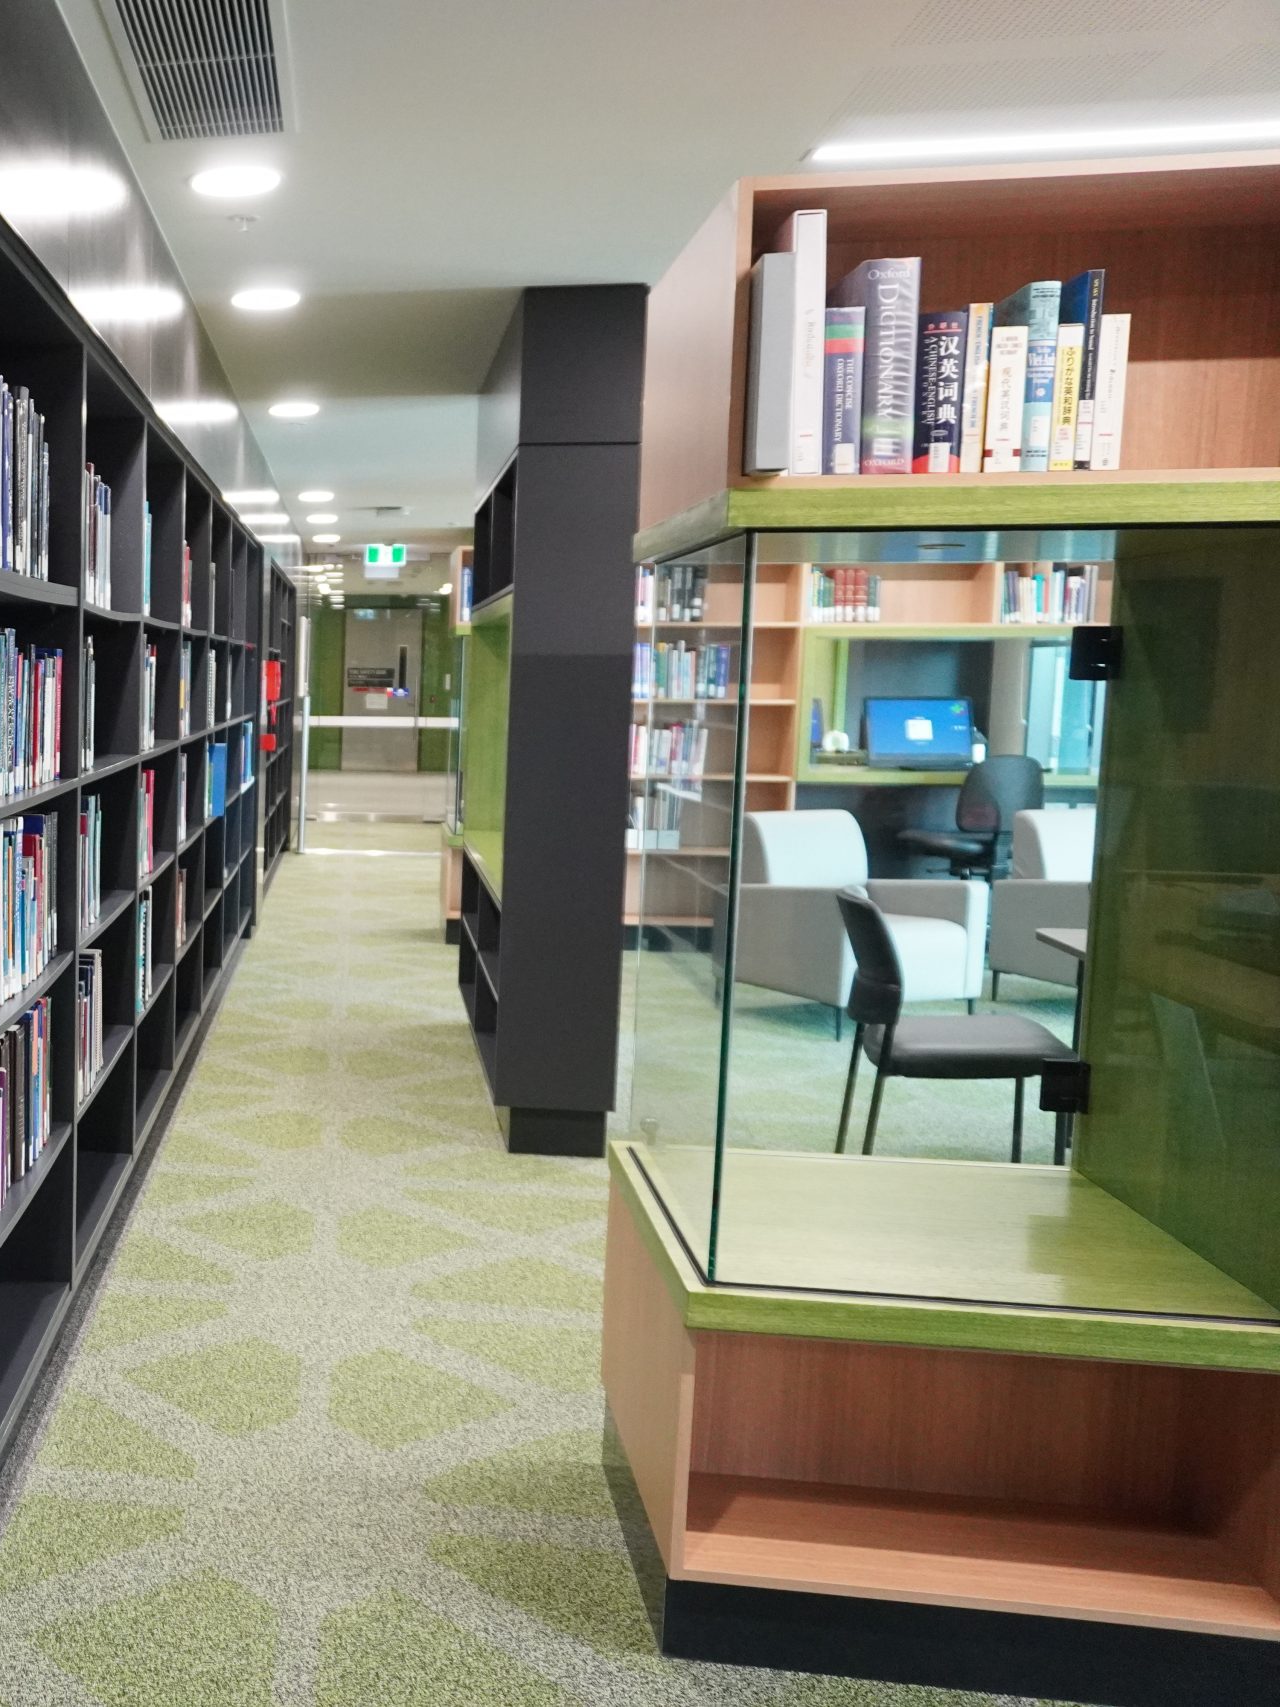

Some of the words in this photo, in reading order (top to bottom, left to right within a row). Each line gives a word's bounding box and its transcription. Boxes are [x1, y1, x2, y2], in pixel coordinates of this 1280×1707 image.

[867, 267, 910, 280] Oxford
[877, 283, 900, 421] DICTIONARY
[936, 335, 960, 424] 汉英词典
[833, 391, 843, 442] DICTIONARY
